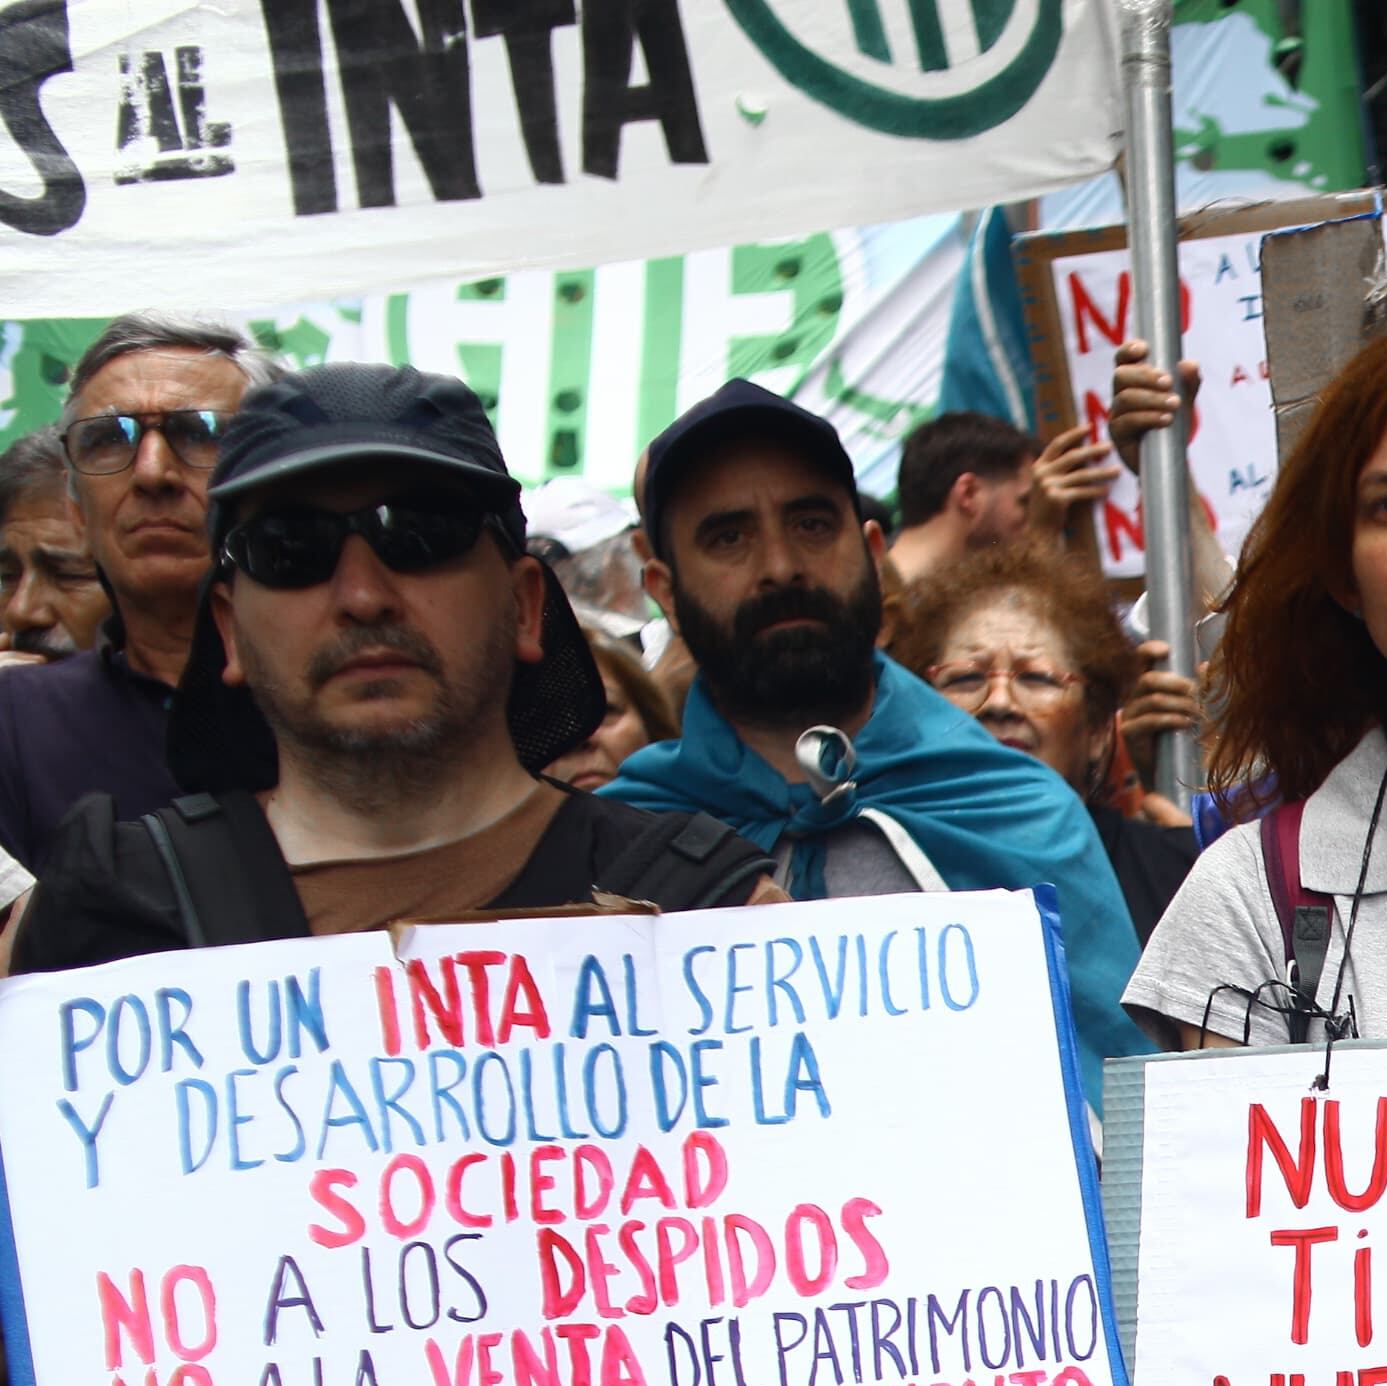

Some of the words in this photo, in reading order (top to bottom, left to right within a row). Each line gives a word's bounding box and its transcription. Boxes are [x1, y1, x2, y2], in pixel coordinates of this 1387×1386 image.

[260, 0, 711, 216] INTA
[59, 987, 204, 1092] POR
[236, 966, 330, 1065] UN
[374, 950, 551, 1057] INTA
[570, 953, 659, 1039] AL
[681, 923, 980, 1036] SERVICIO
[56, 1090, 115, 1190] Y
[174, 1041, 628, 1176] DESARROLLO
[649, 1038, 730, 1134] DE
[749, 1030, 832, 1126] LA
[307, 1129, 729, 1249] SOCIEDAD
[96, 1263, 217, 1372] NO
[263, 1254, 325, 1346] A
[361, 1231, 488, 1333] LOS
[537, 1196, 890, 1319] DESPIDOS
